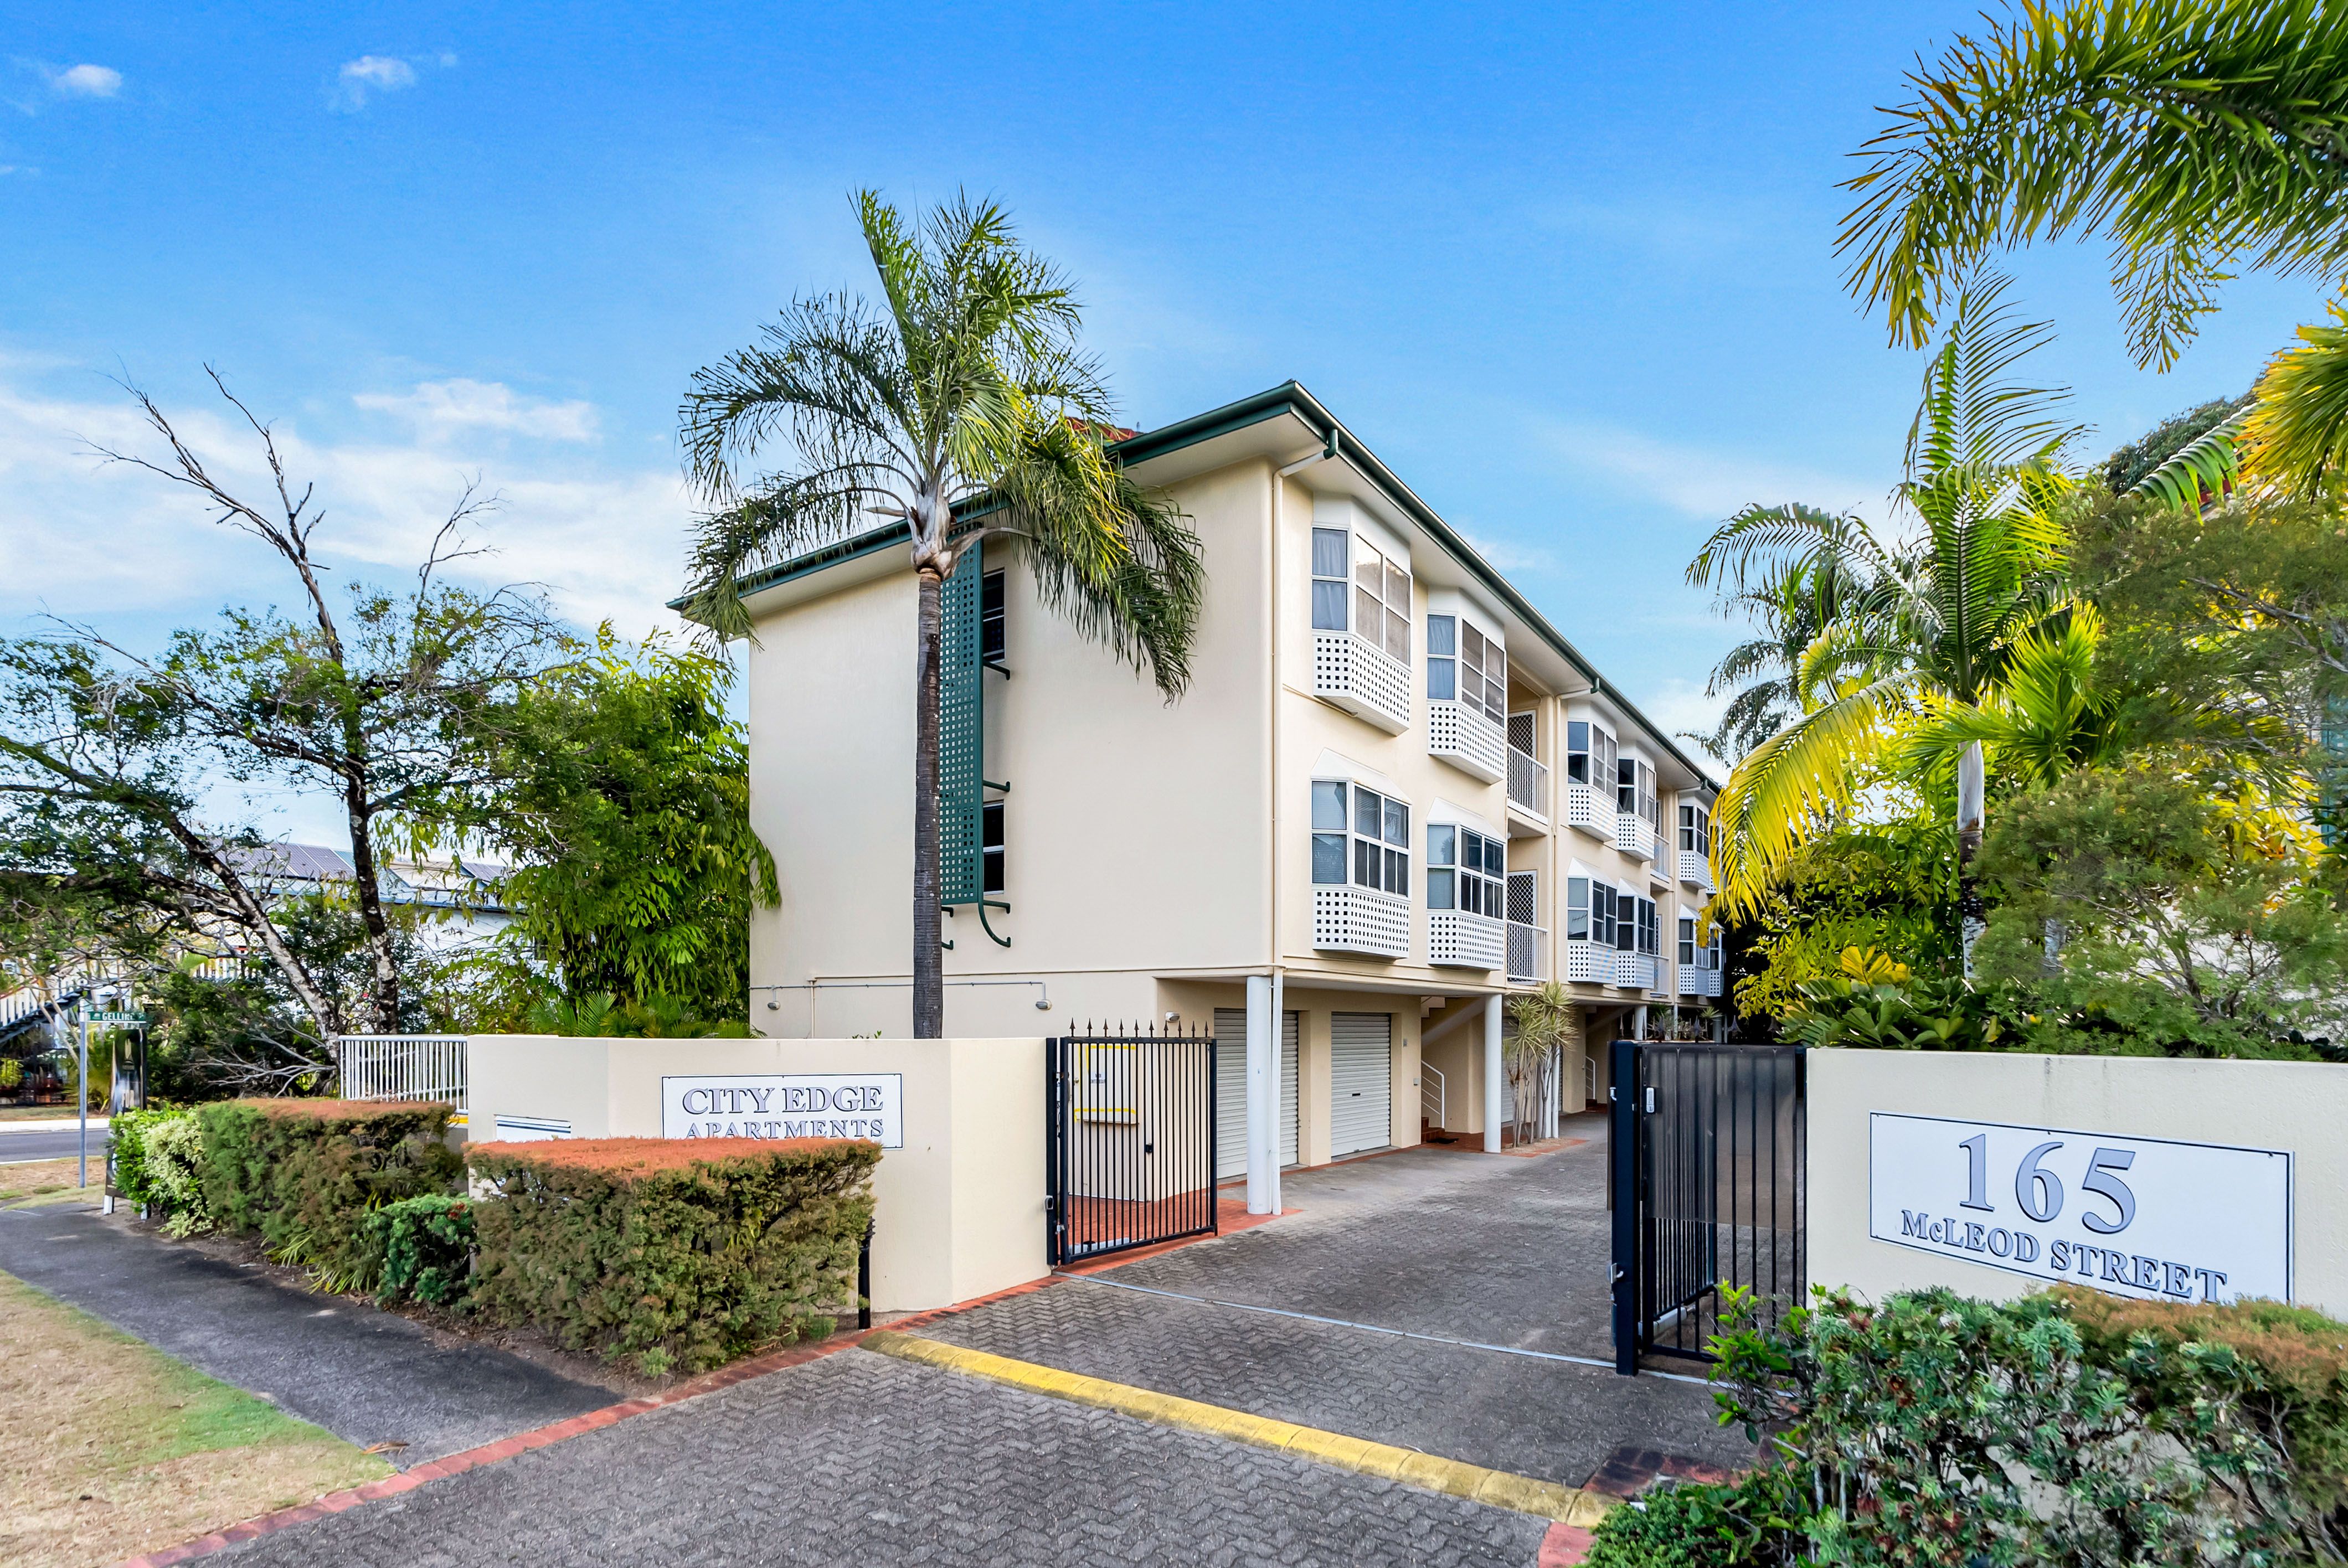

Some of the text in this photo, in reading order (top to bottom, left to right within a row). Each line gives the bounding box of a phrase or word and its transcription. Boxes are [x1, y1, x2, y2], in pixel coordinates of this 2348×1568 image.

[682, 1086, 883, 1115] CITY EDGE
[684, 1118, 884, 1139] APARTMENTS
[1959, 1133, 2136, 1234] 165
[1901, 1210, 2227, 1303] McLEOD STREET
